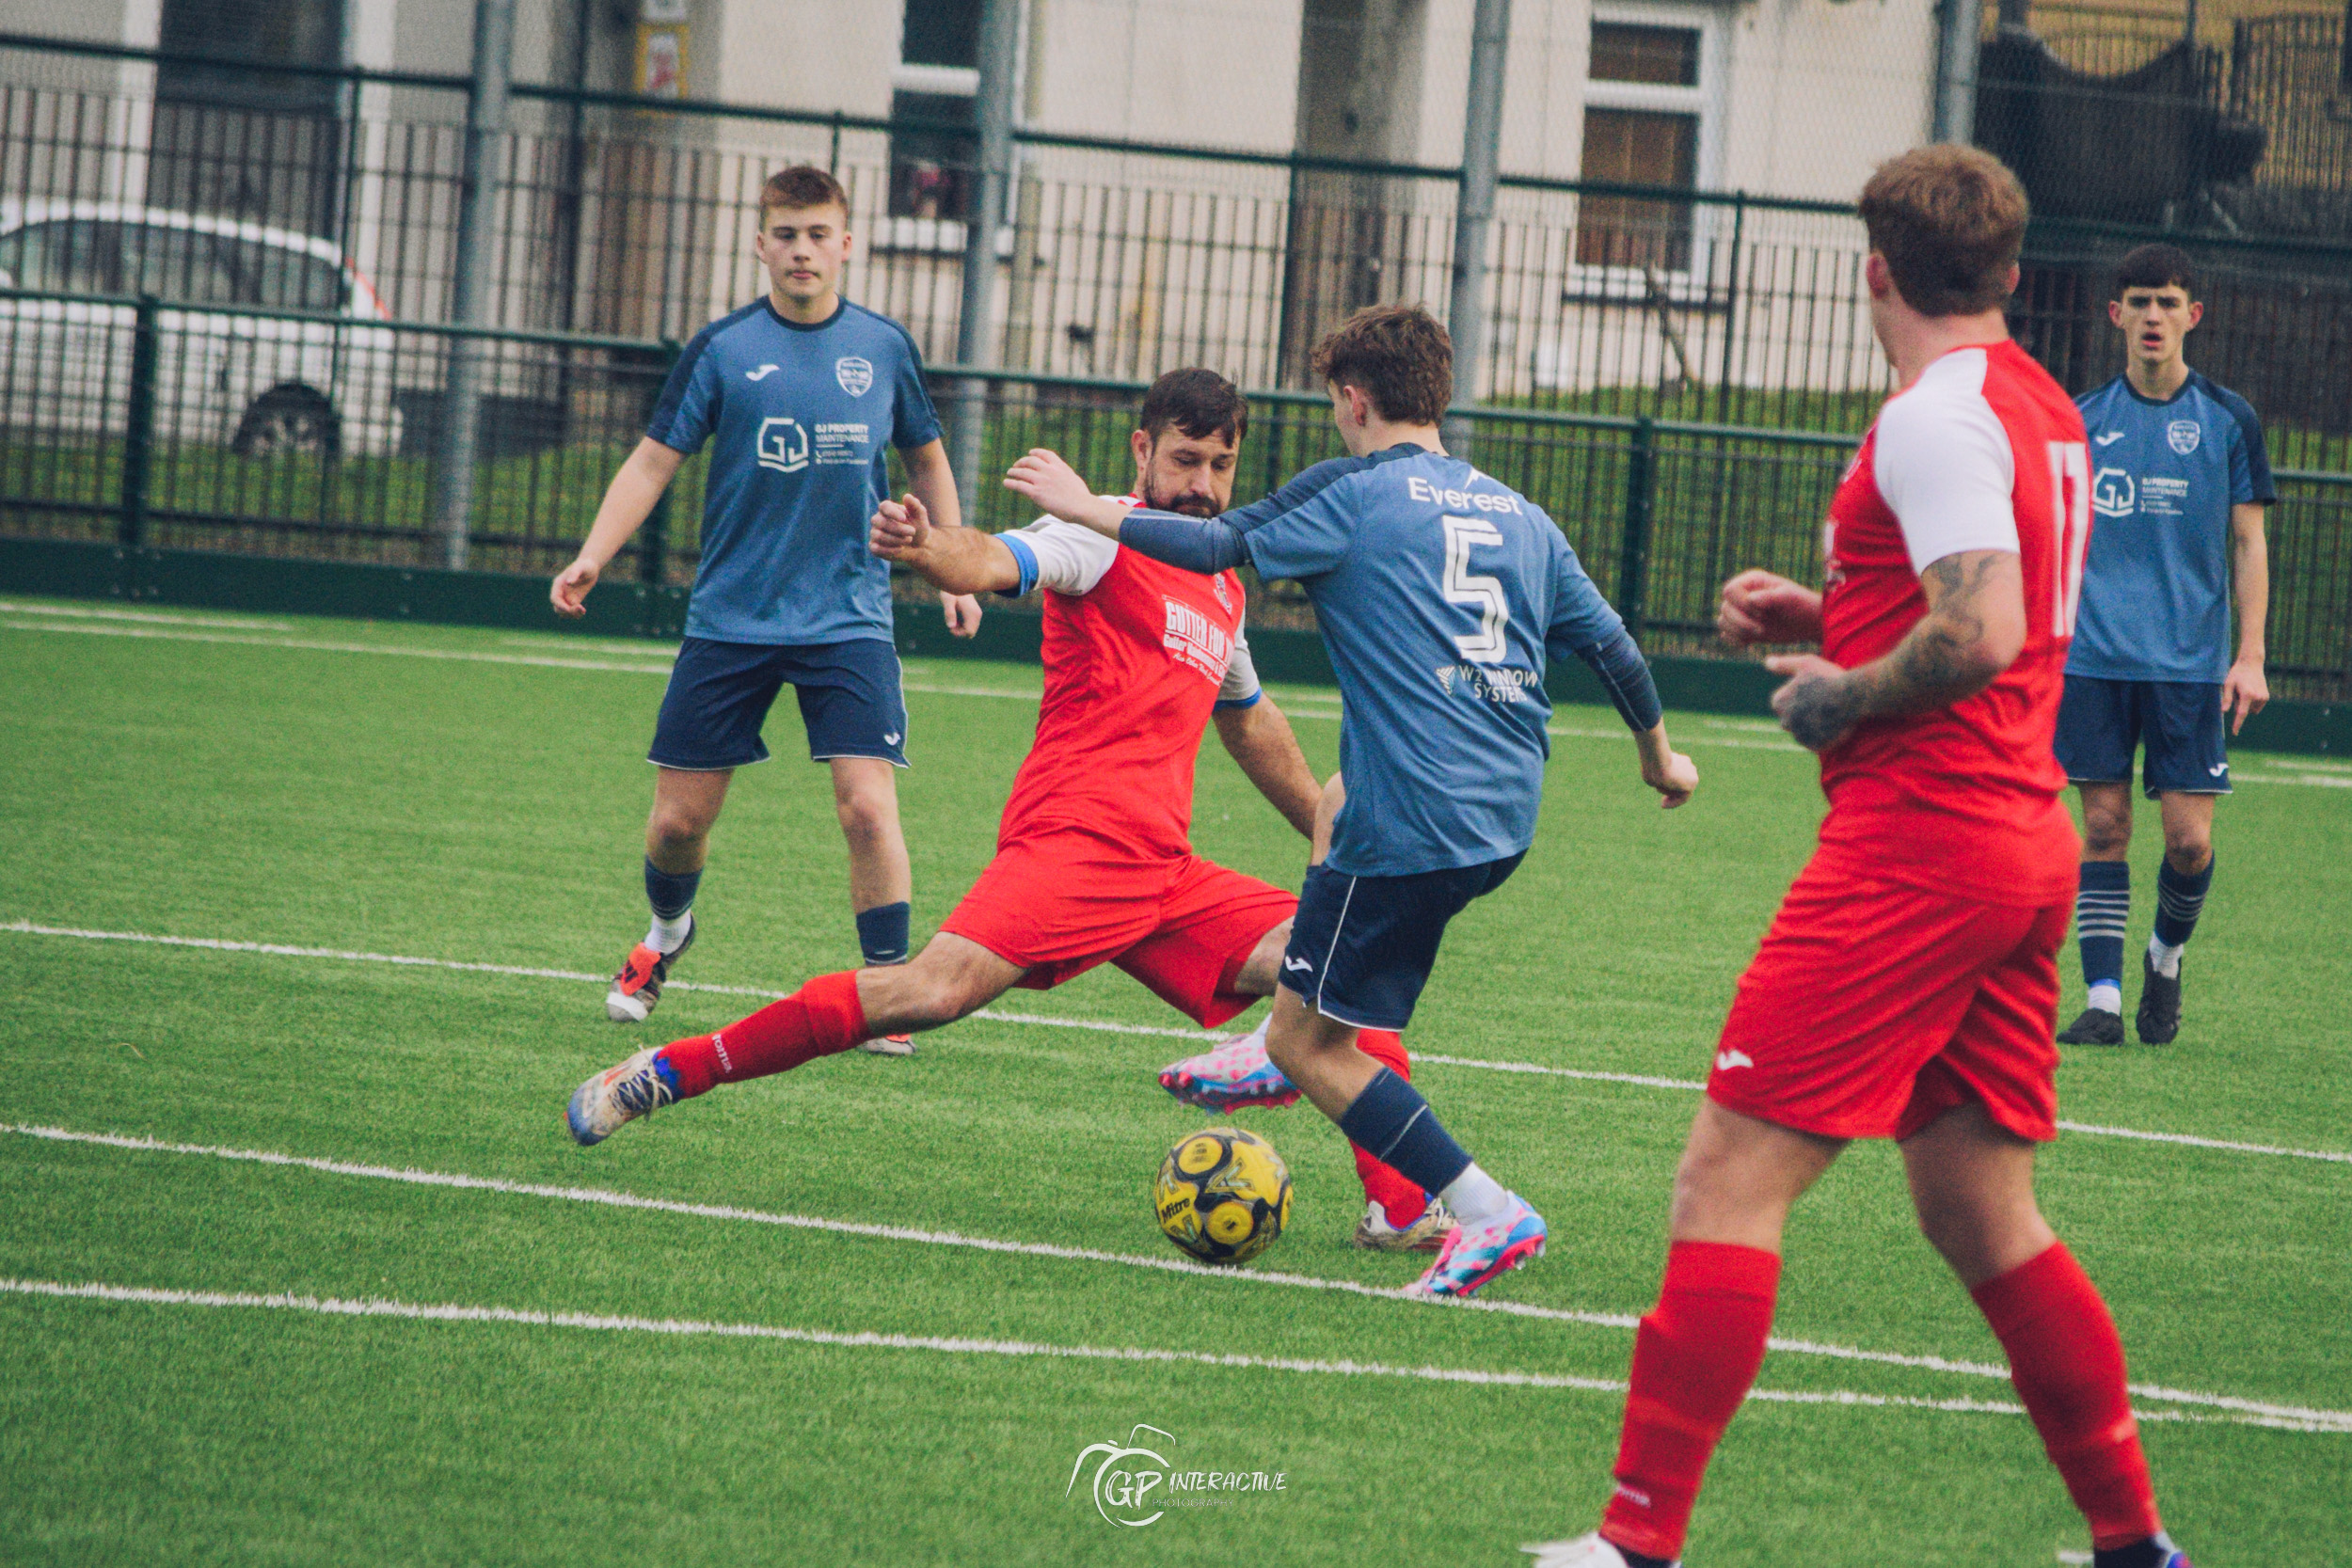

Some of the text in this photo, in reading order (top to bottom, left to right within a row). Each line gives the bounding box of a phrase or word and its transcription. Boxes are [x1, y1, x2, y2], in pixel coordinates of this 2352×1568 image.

[828, 423, 869, 434] PROPERTY
[1407, 476, 1523, 516] Everest
[1442, 515, 1509, 664] 5
[1165, 600, 1208, 648] GUTTER
[1160, 1197, 1191, 1225] Mitre
